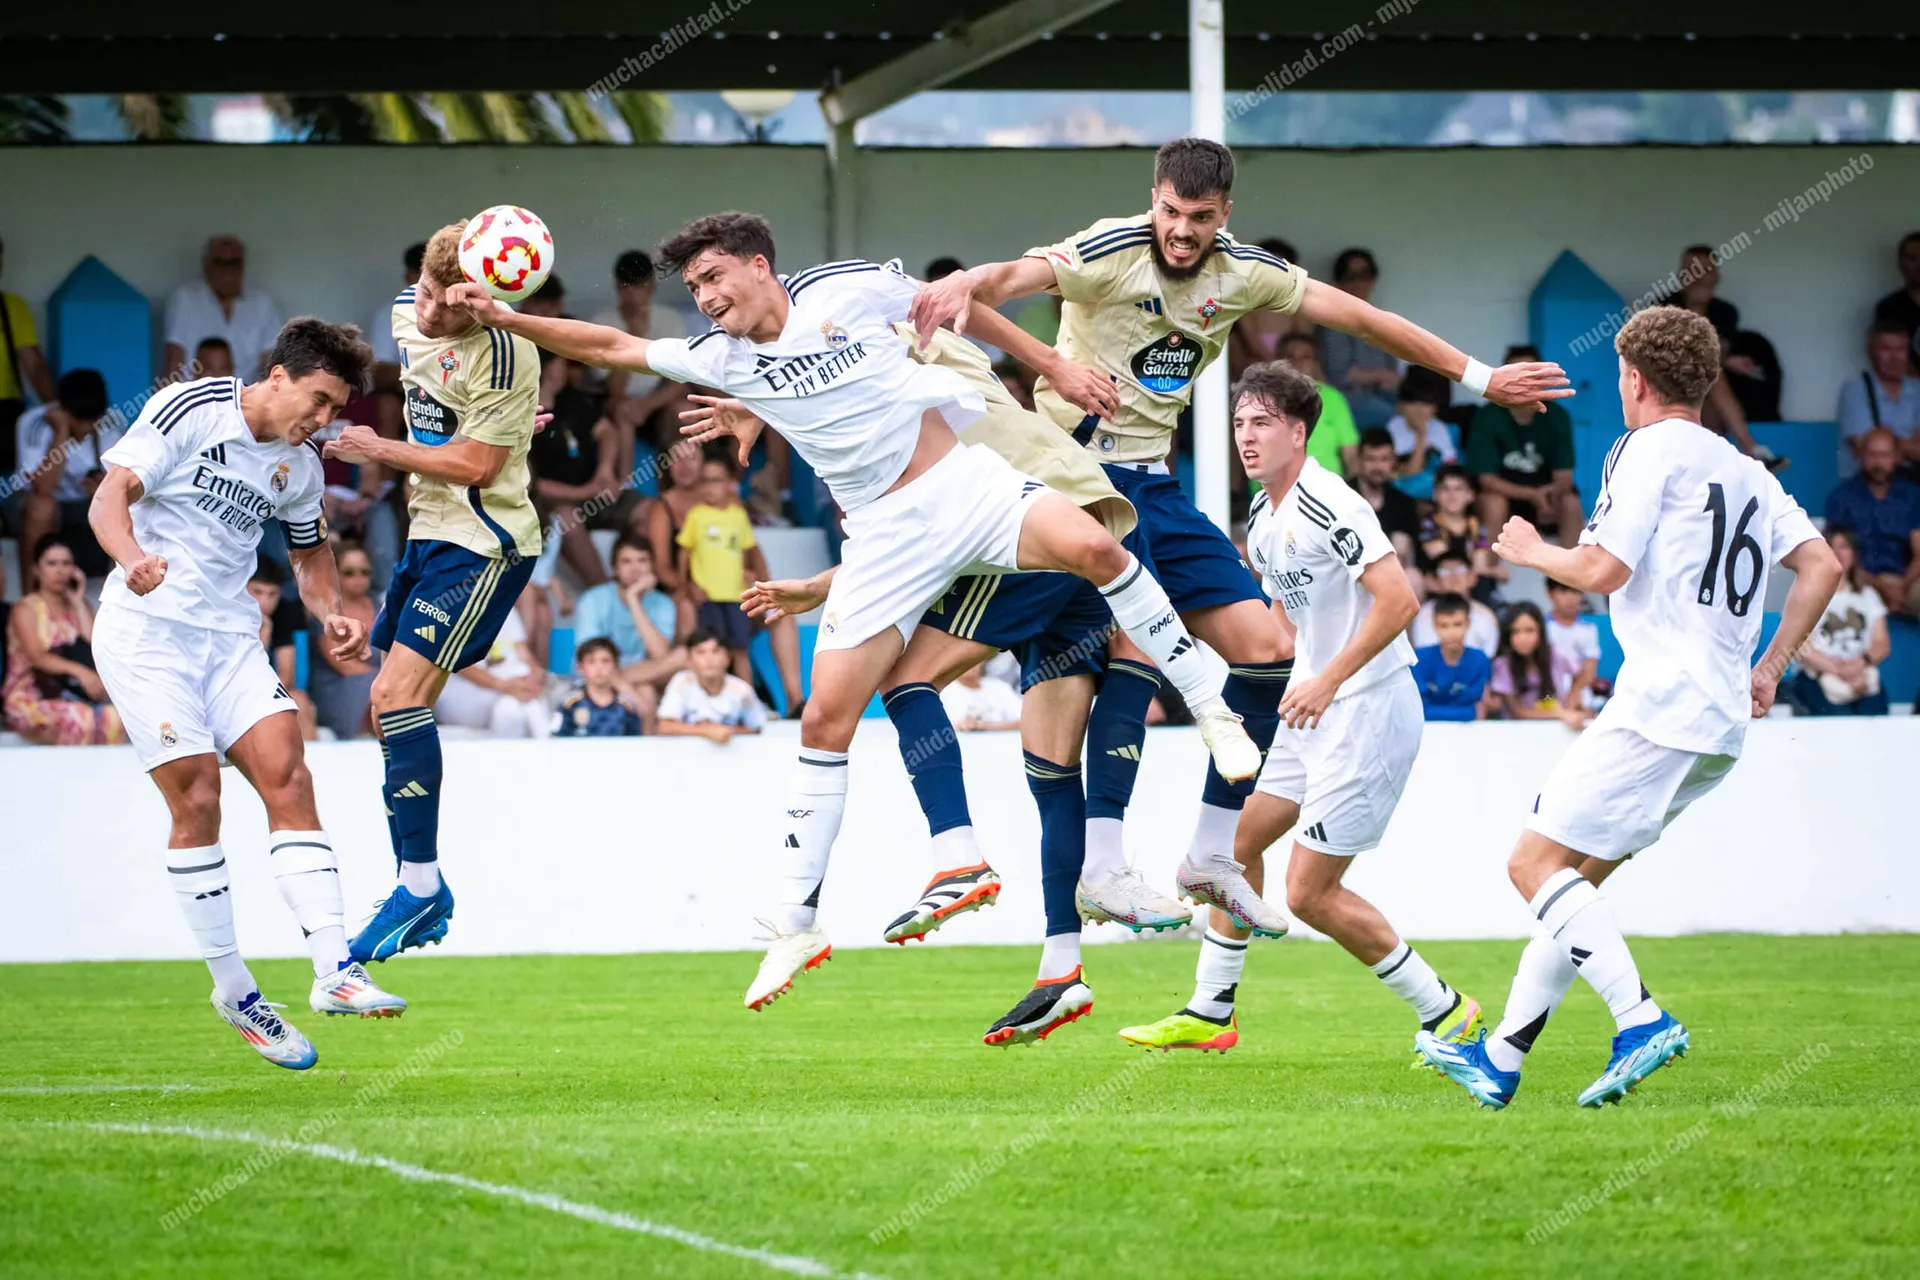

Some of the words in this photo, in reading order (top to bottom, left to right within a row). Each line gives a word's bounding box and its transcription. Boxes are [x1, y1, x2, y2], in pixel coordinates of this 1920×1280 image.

[817, 342, 867, 385] BETTER
[1144, 348, 1195, 363] Estrella
[1143, 360, 1188, 377] Galicia
[409, 397, 444, 418] Estrella
[192, 465, 276, 519] Emirates
[196, 494, 224, 513] FLY
[1697, 482, 1764, 618] 16
[412, 598, 451, 627] FERROL
